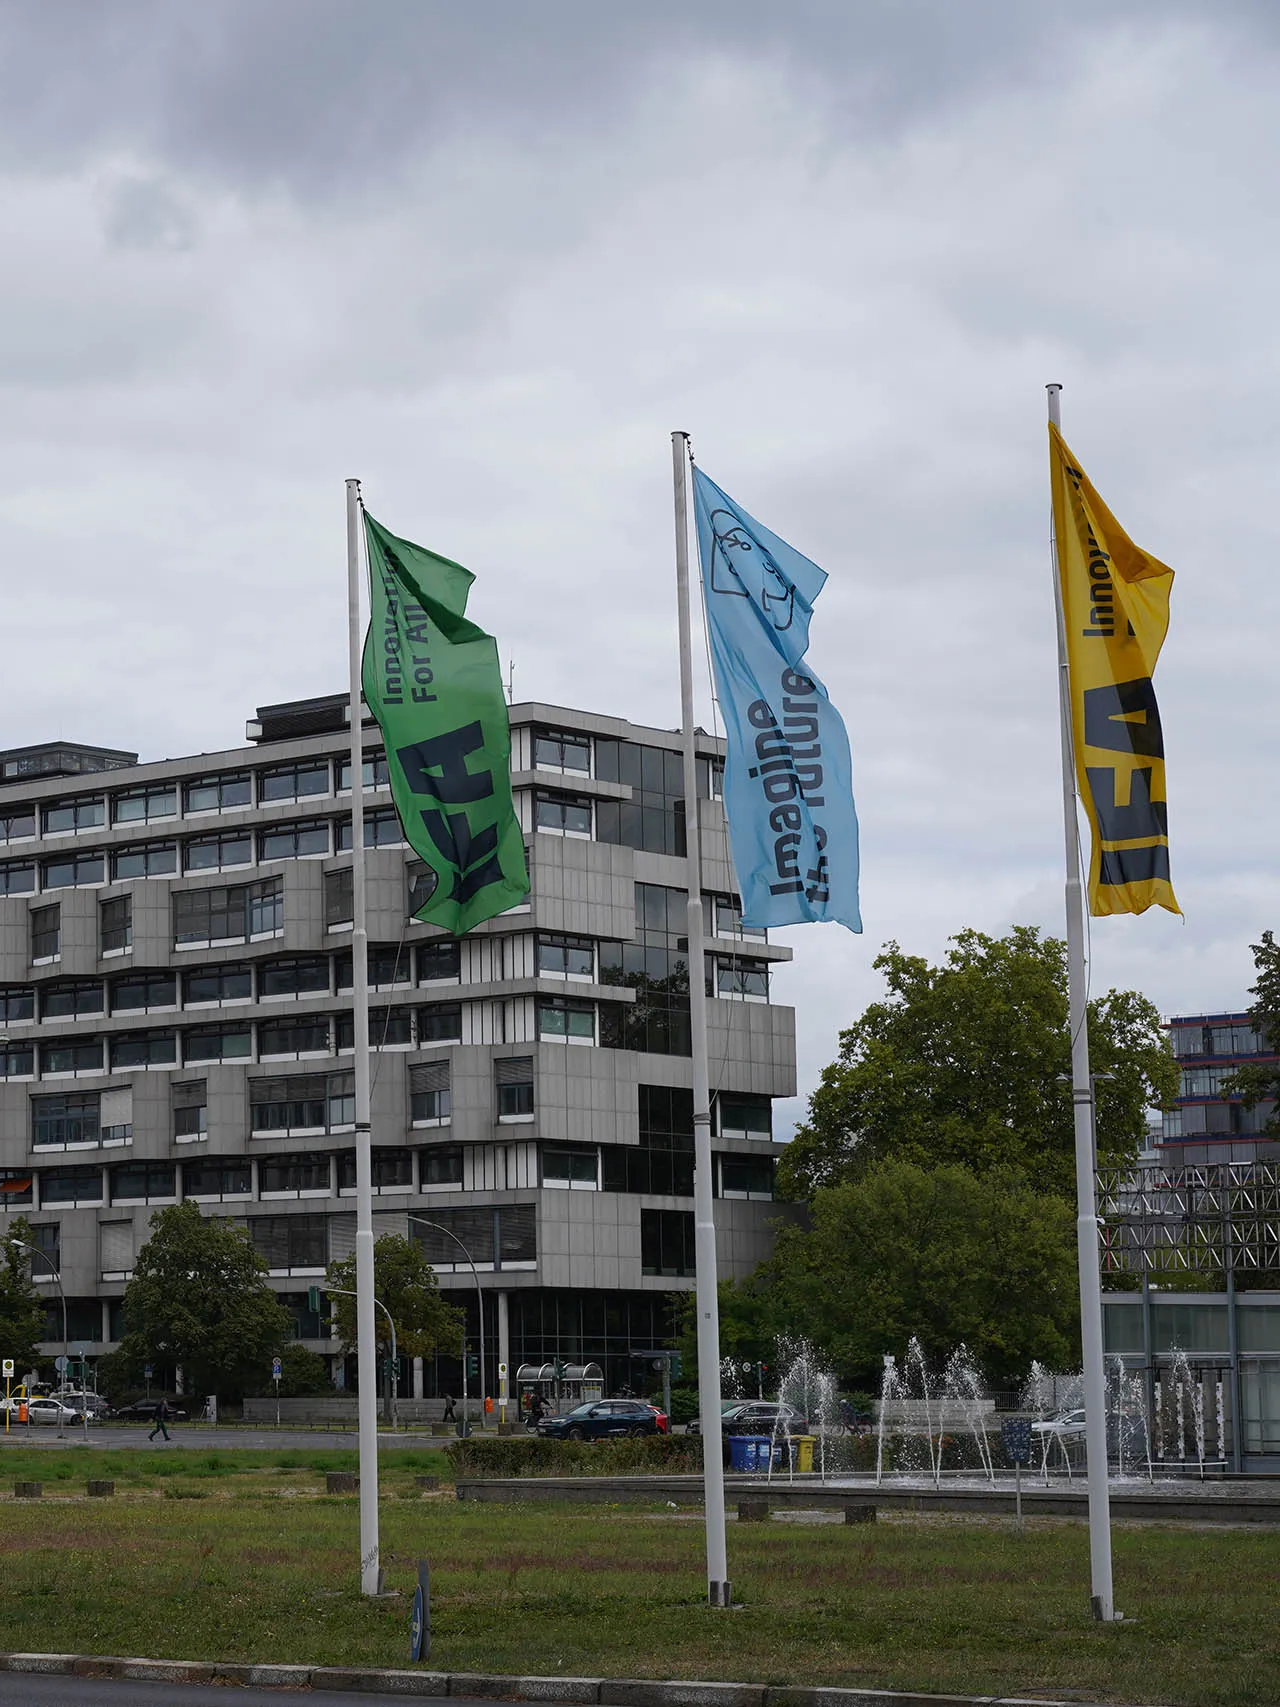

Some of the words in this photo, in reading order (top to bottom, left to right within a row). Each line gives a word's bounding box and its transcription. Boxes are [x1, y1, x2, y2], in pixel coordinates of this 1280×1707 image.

[383, 546, 403, 704] Innovati
[411, 655, 438, 702] For
[396, 720, 505, 904] IFA
[747, 697, 804, 895] Imagine
[1083, 677, 1170, 885] IFA
